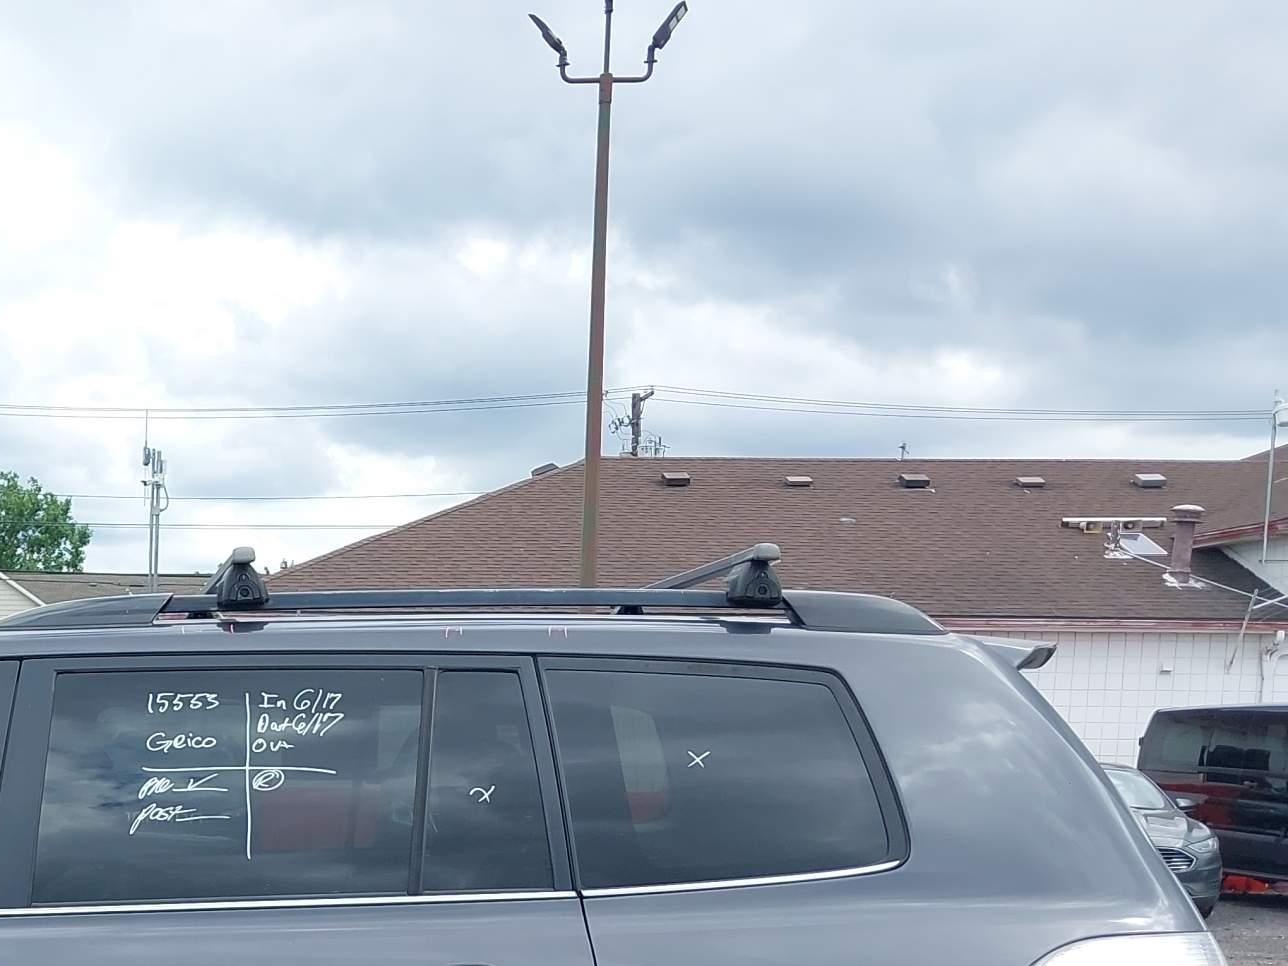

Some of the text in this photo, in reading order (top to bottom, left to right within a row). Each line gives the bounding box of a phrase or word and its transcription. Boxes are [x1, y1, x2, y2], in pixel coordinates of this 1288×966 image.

[147, 692, 220, 713] 15553
[258, 688, 342, 714] In 6/17
[146, 732, 217, 752] Geico
